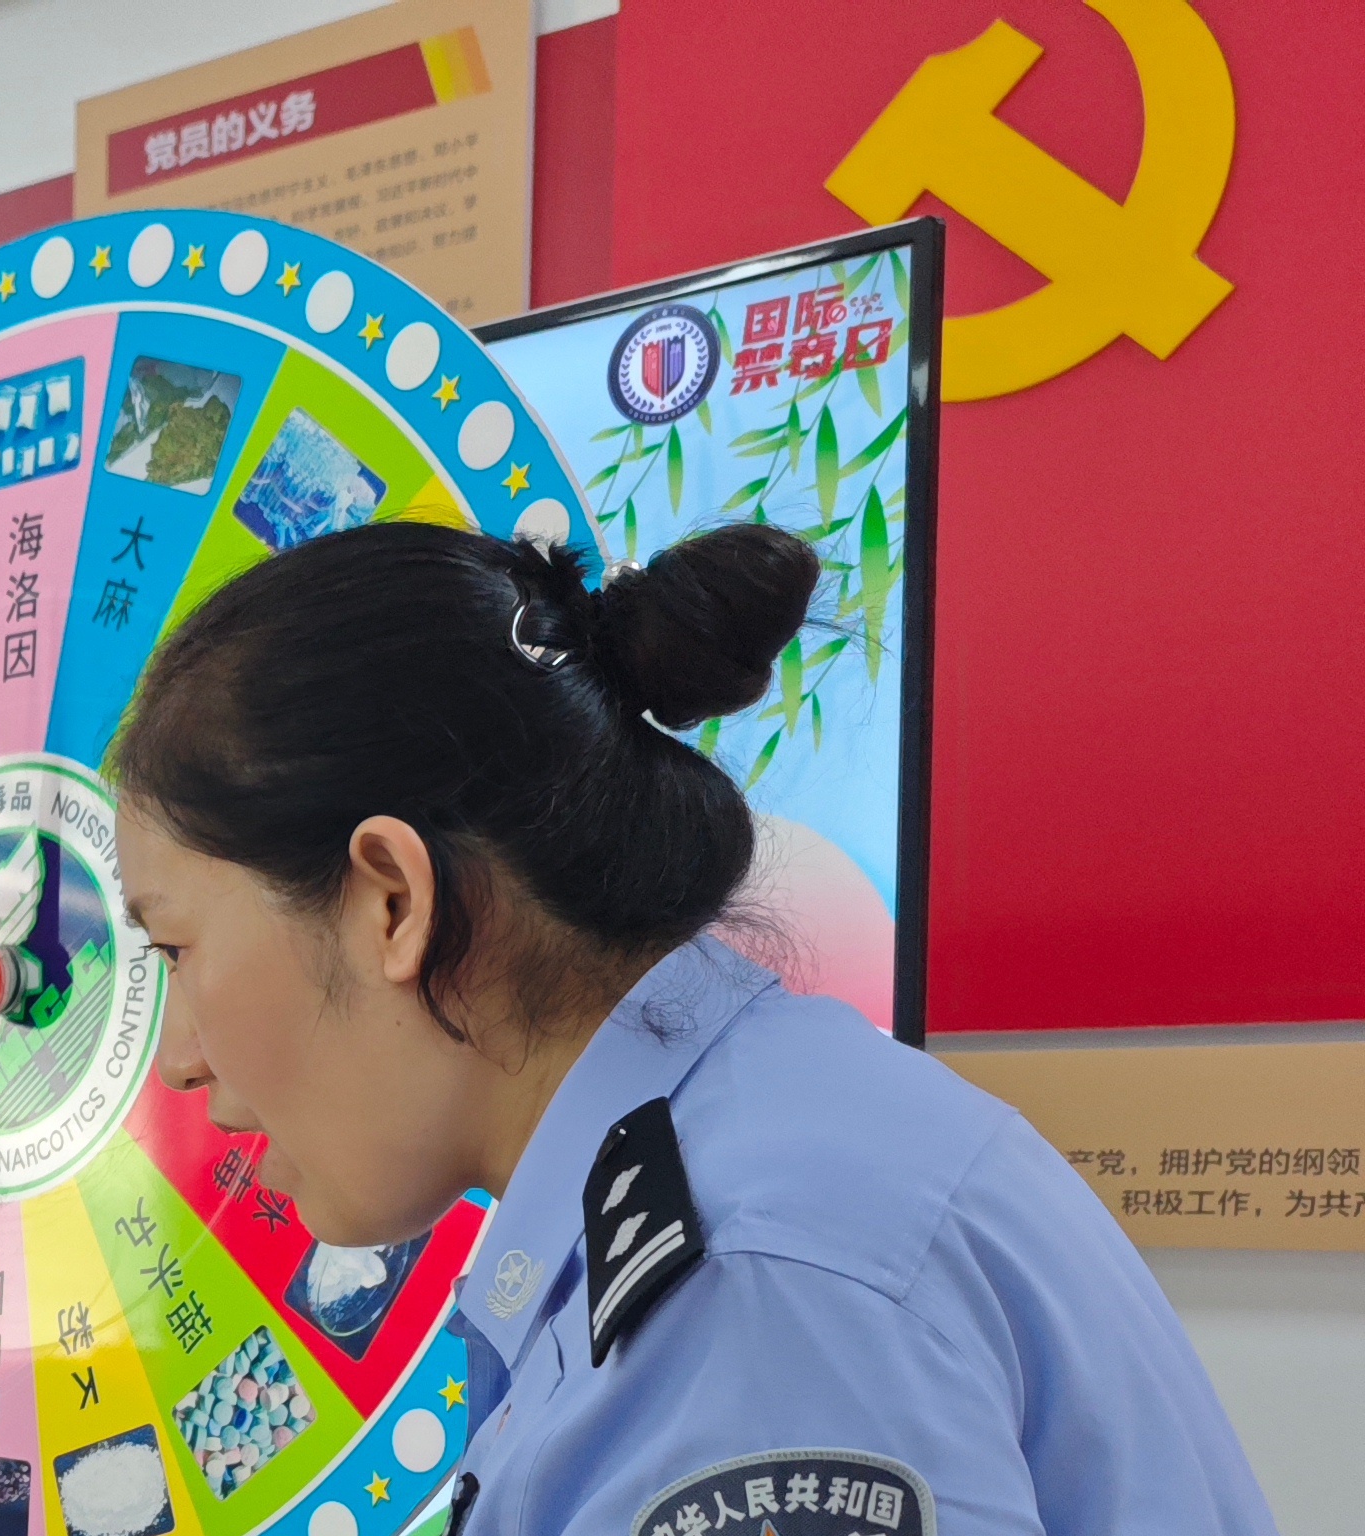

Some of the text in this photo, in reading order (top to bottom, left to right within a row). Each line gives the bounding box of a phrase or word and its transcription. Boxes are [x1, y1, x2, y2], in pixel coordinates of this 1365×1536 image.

[144, 90, 316, 175] 党员的义务
[742, 283, 848, 346] 国际
[3, 512, 44, 683] 海洛因
[92, 515, 153, 631] 大麻
[114, 1196, 213, 1354] 摇头丸
[58, 1301, 100, 1410] K粉
